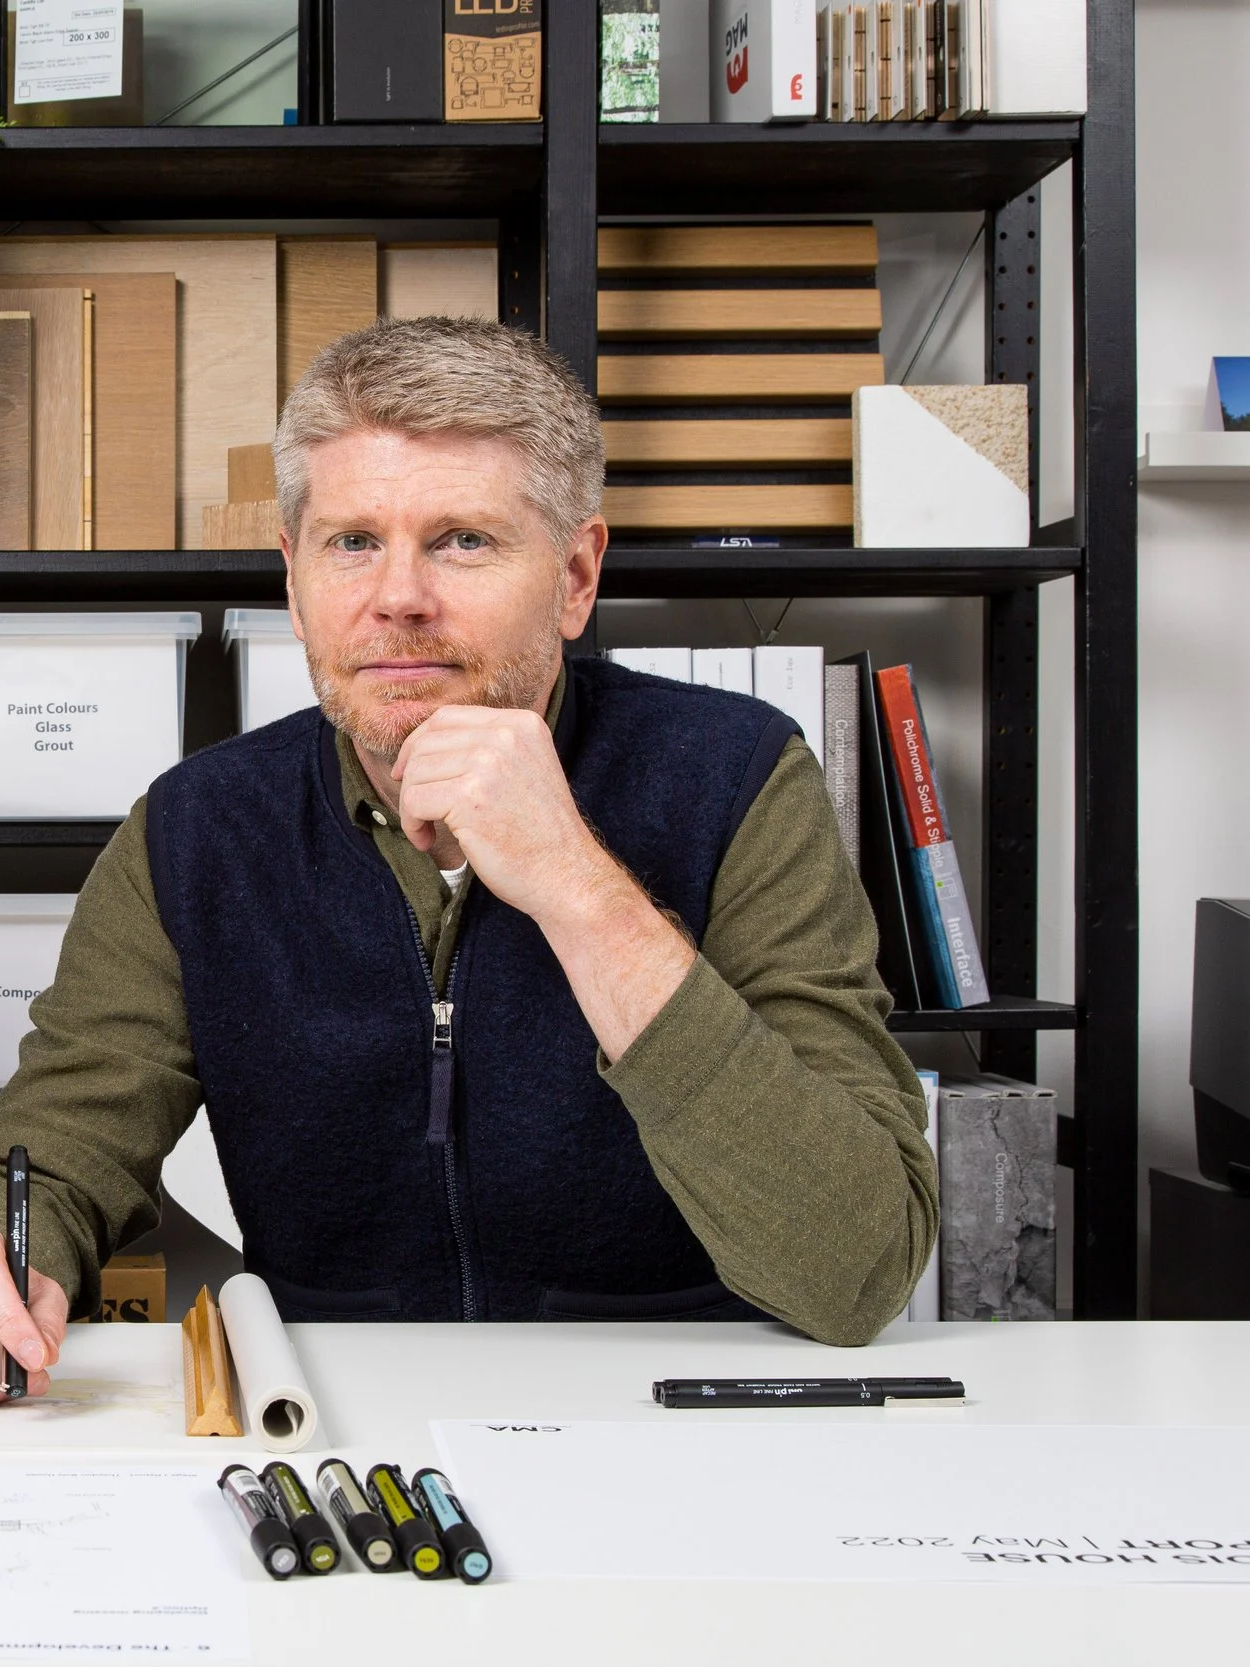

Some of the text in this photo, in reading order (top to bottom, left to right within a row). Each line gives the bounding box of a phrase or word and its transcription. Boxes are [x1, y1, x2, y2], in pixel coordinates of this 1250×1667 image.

[70, 32, 84, 42] 200
[94, 30, 110, 40] 300
[726, 12, 748, 56] MAG
[8, 702, 99, 716] Paint Colours
[35, 721, 72, 733] Glass
[34, 740, 74, 752] Grout
[834, 718, 848, 808] Contemplation
[902, 718, 947, 868] Polichrome Solid & Stipple
[947, 917, 976, 988] Interface
[994, 1152, 1008, 1224] Composure
[836, 1536, 955, 1547] 2022
[972, 1534, 1068, 1548] May
[962, 1552, 1158, 1564] HOUSE
